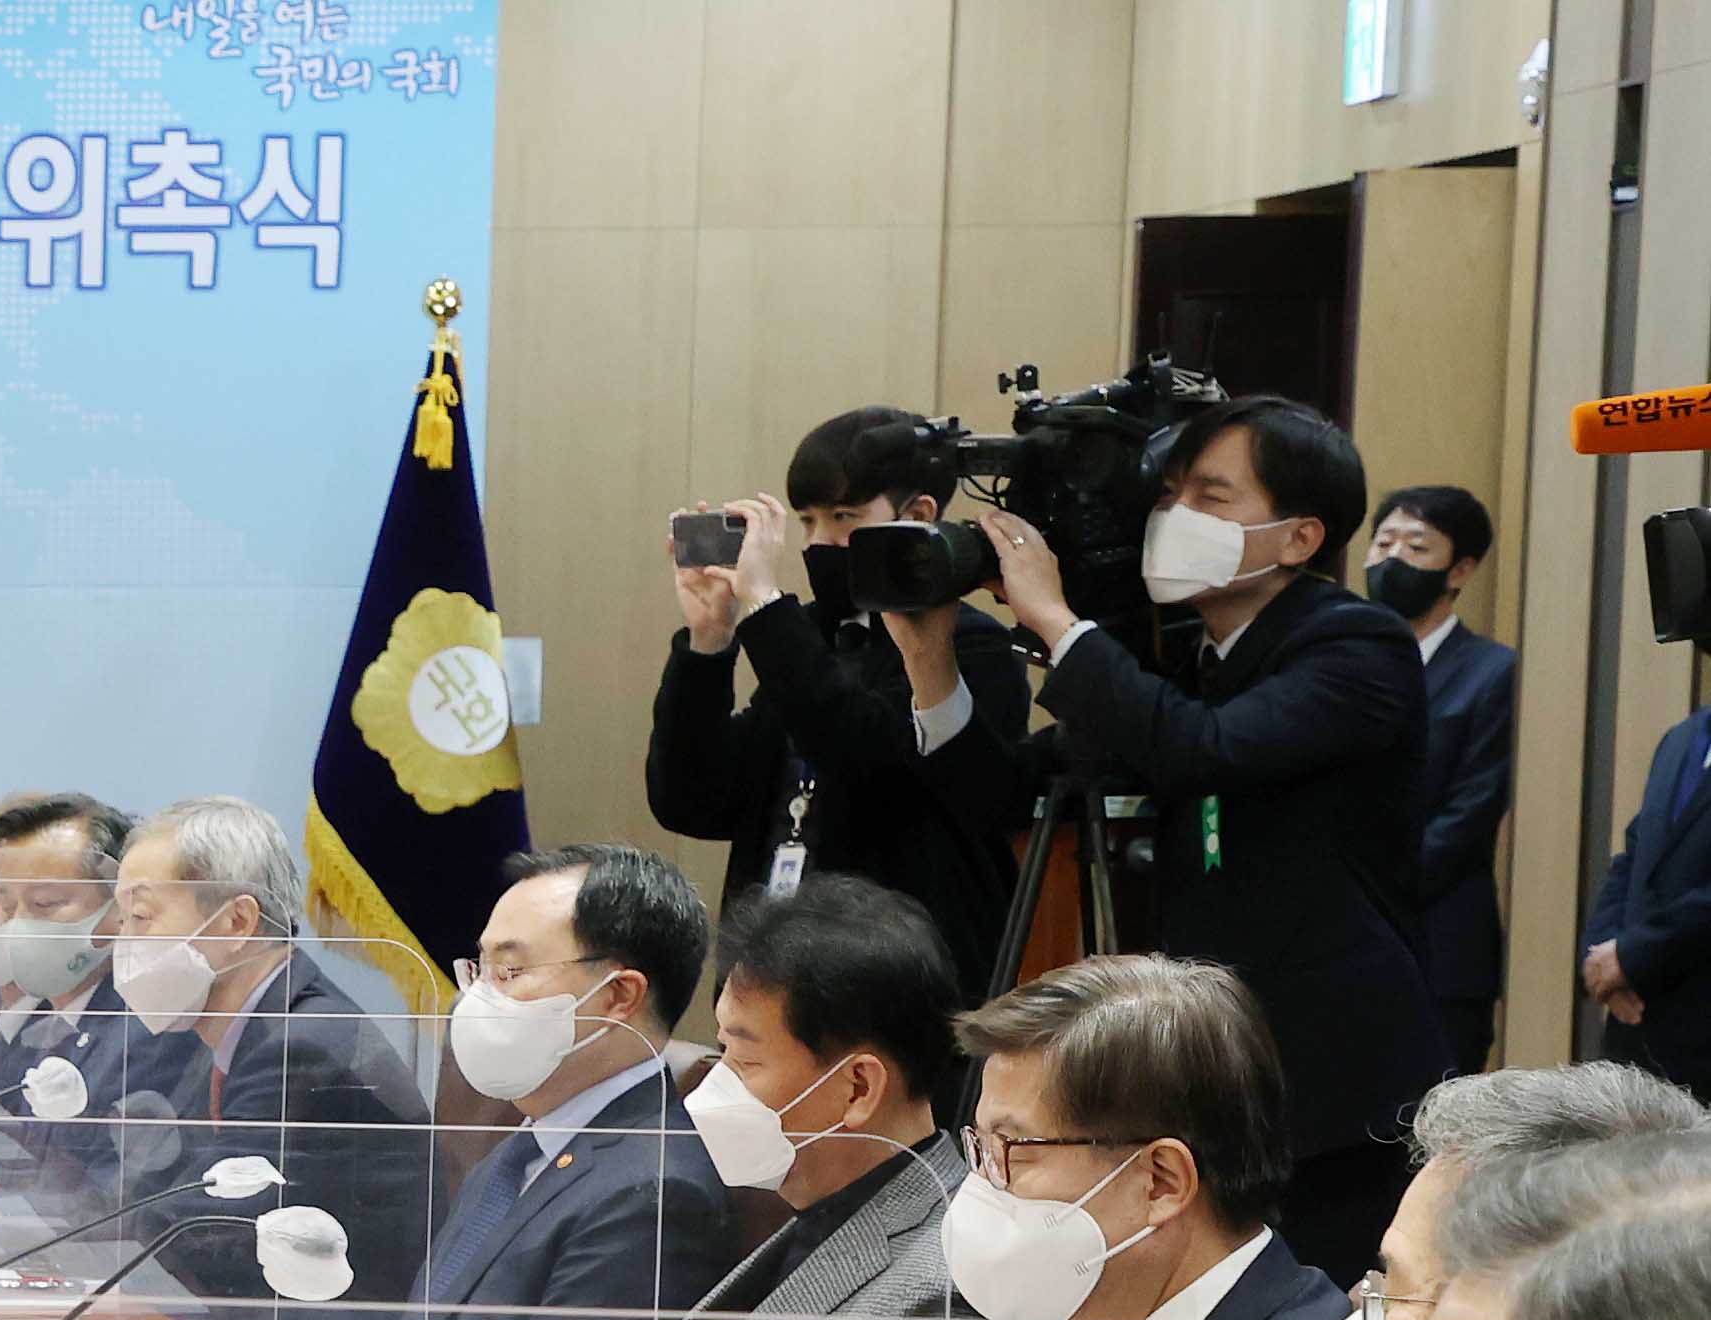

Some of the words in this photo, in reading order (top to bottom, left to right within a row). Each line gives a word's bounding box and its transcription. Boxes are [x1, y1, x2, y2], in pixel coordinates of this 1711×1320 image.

[141, 0, 264, 59] 내일을
[274, 0, 349, 43] 여는
[251, 44, 373, 111] 국민의
[379, 47, 460, 101] 국회
